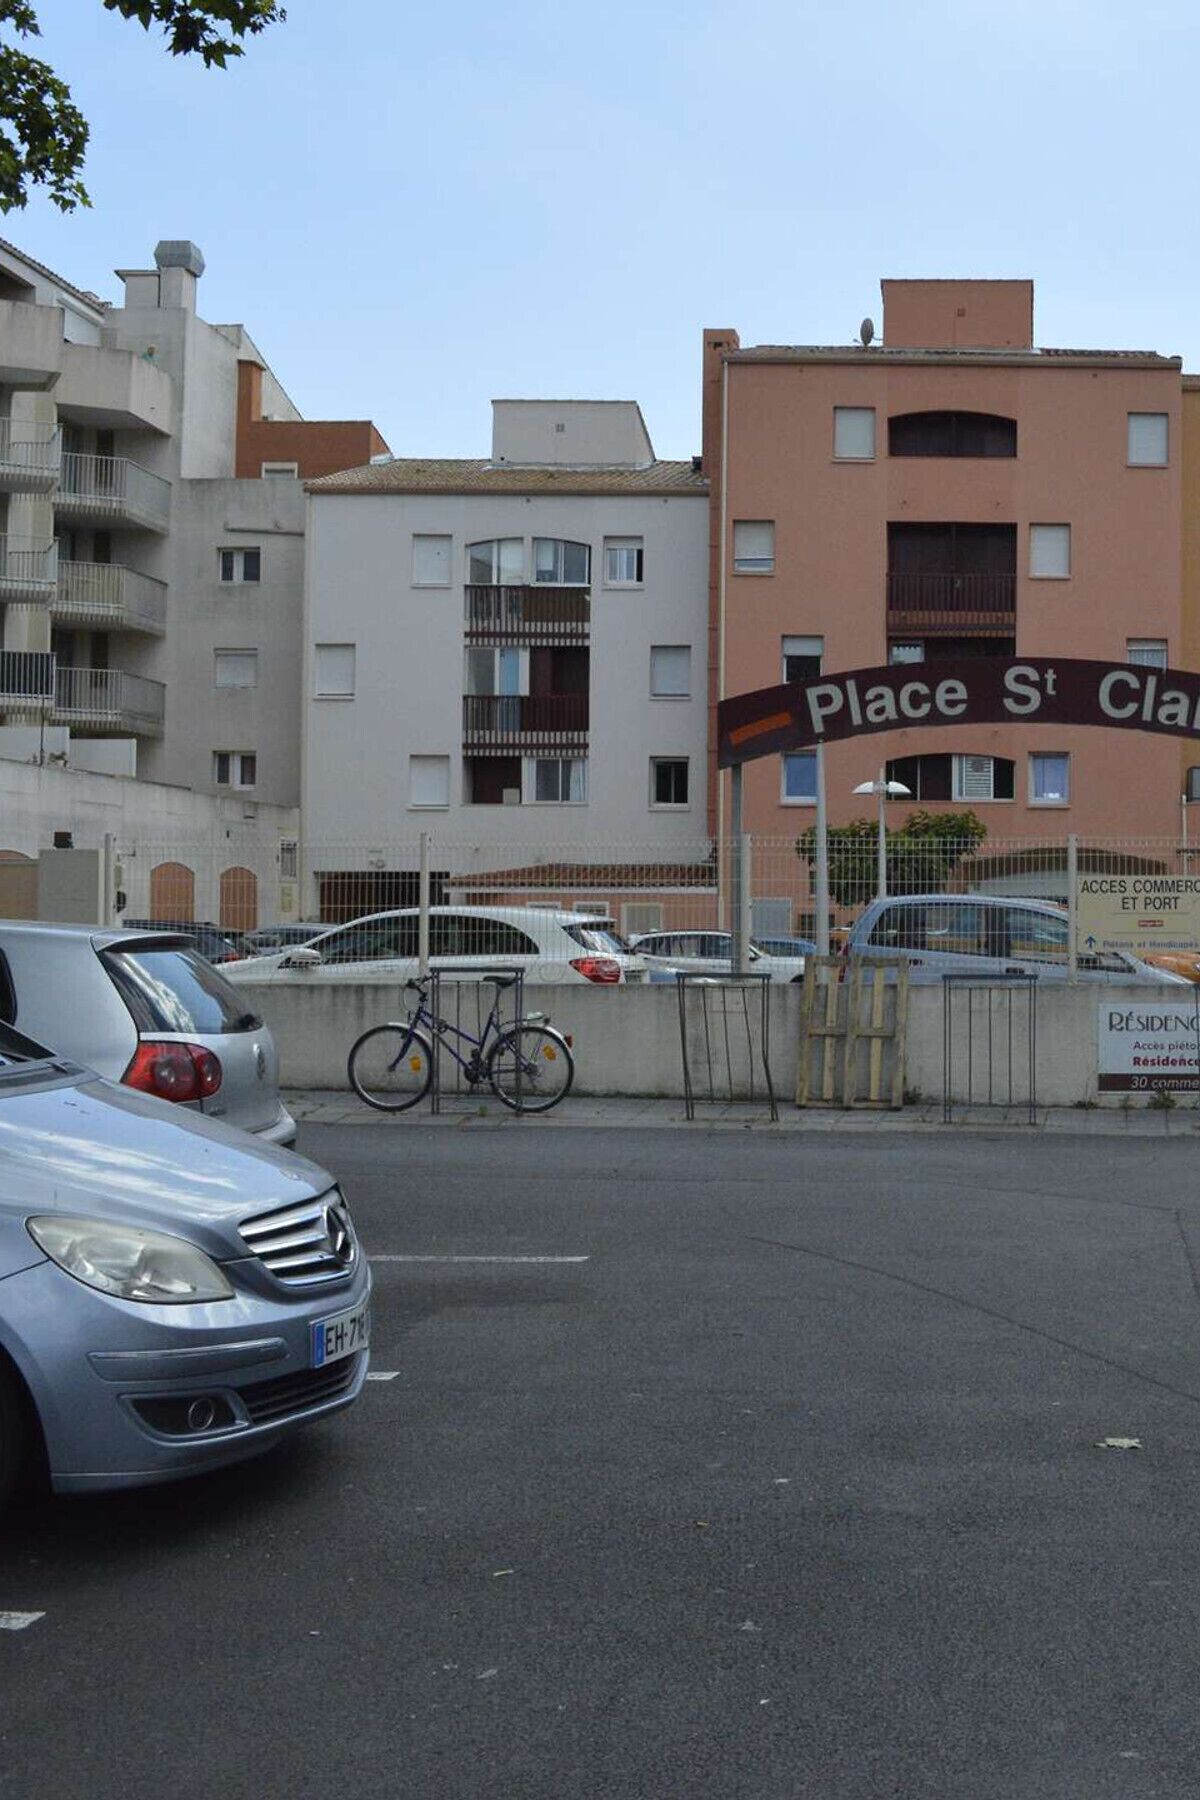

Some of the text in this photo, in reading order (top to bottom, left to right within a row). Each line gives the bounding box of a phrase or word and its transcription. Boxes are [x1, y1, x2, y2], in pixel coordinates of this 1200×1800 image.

[805, 677, 969, 734] Place
[1003, 664, 1057, 715] St
[1081, 879, 1127, 894] ACCES
[1121, 896, 1180, 911] ET PORT
[1133, 1040, 1164, 1050] Accès
[1133, 1054, 1200, 1067] Résidence
[1131, 1076, 1148, 1089] 30
